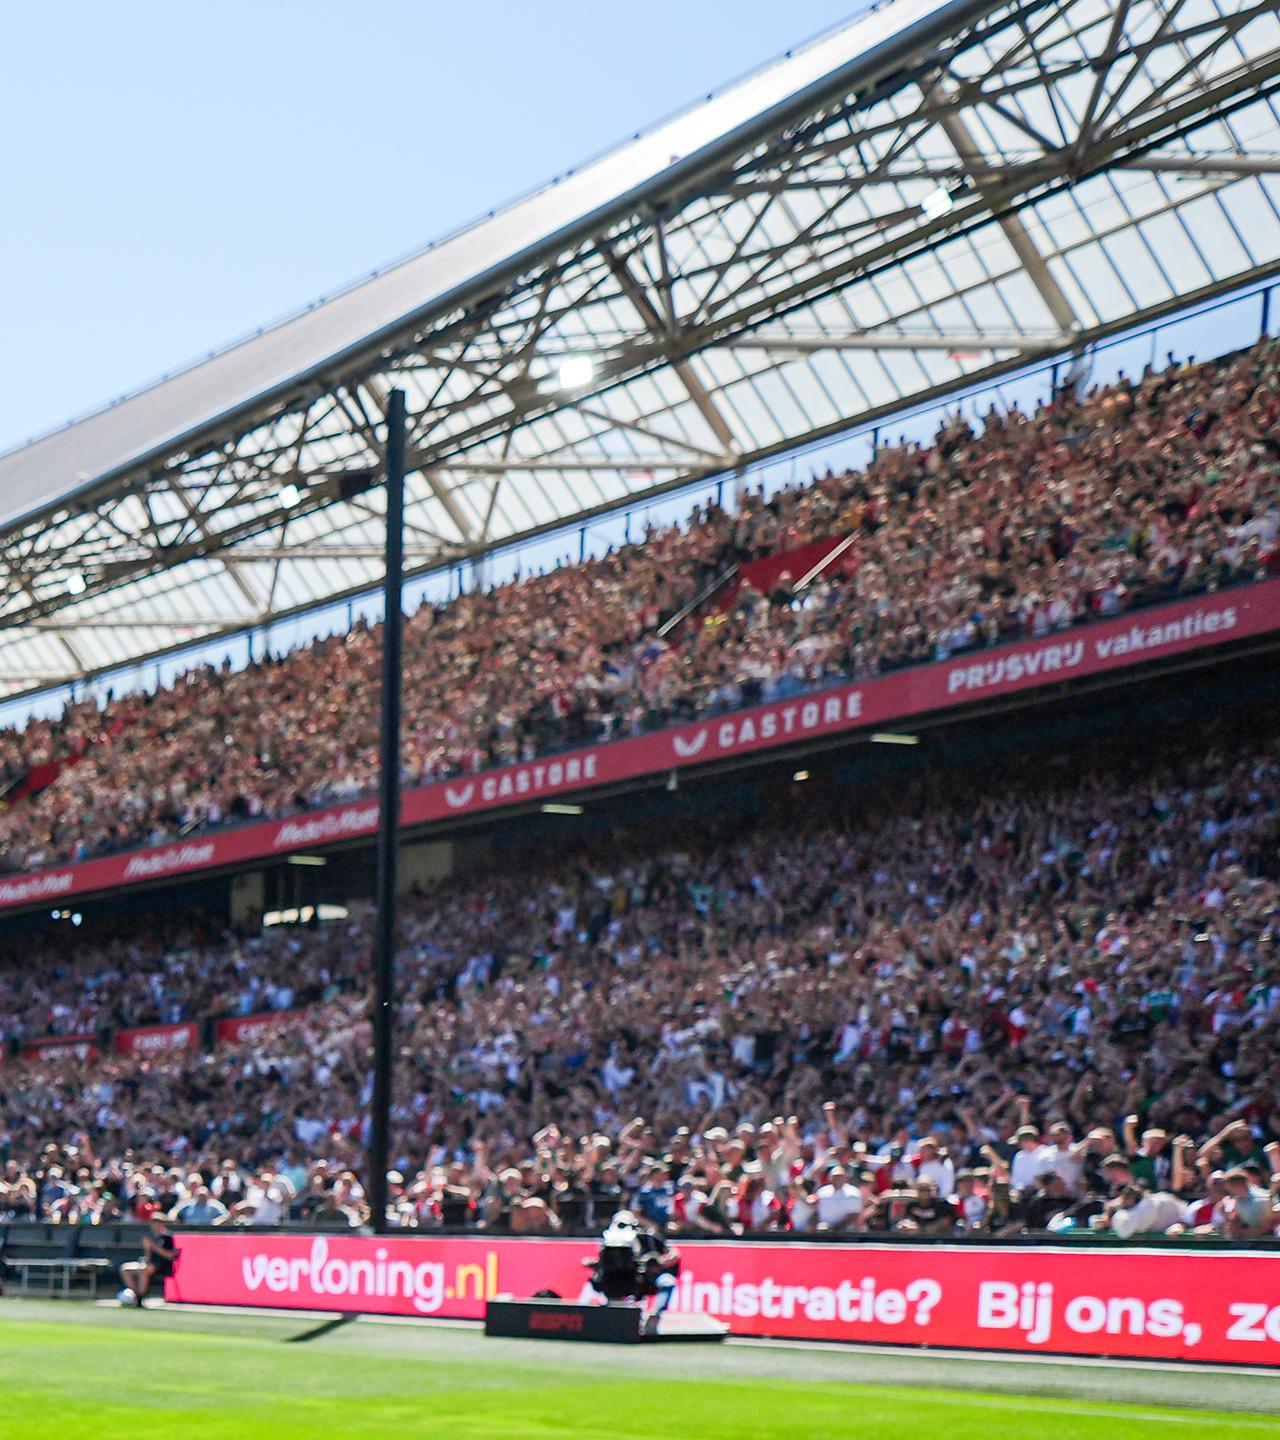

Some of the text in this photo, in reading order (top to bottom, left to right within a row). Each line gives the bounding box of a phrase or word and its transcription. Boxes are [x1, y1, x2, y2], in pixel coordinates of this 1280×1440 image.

[1095, 607, 1238, 659] vakanties
[718, 691, 863, 748] CASTORE
[481, 754, 597, 801] CASTORE
[242, 1236, 499, 1313] verloning.nl
[977, 1281, 1054, 1344] Bij
[1064, 1296, 1203, 1347] ons,
